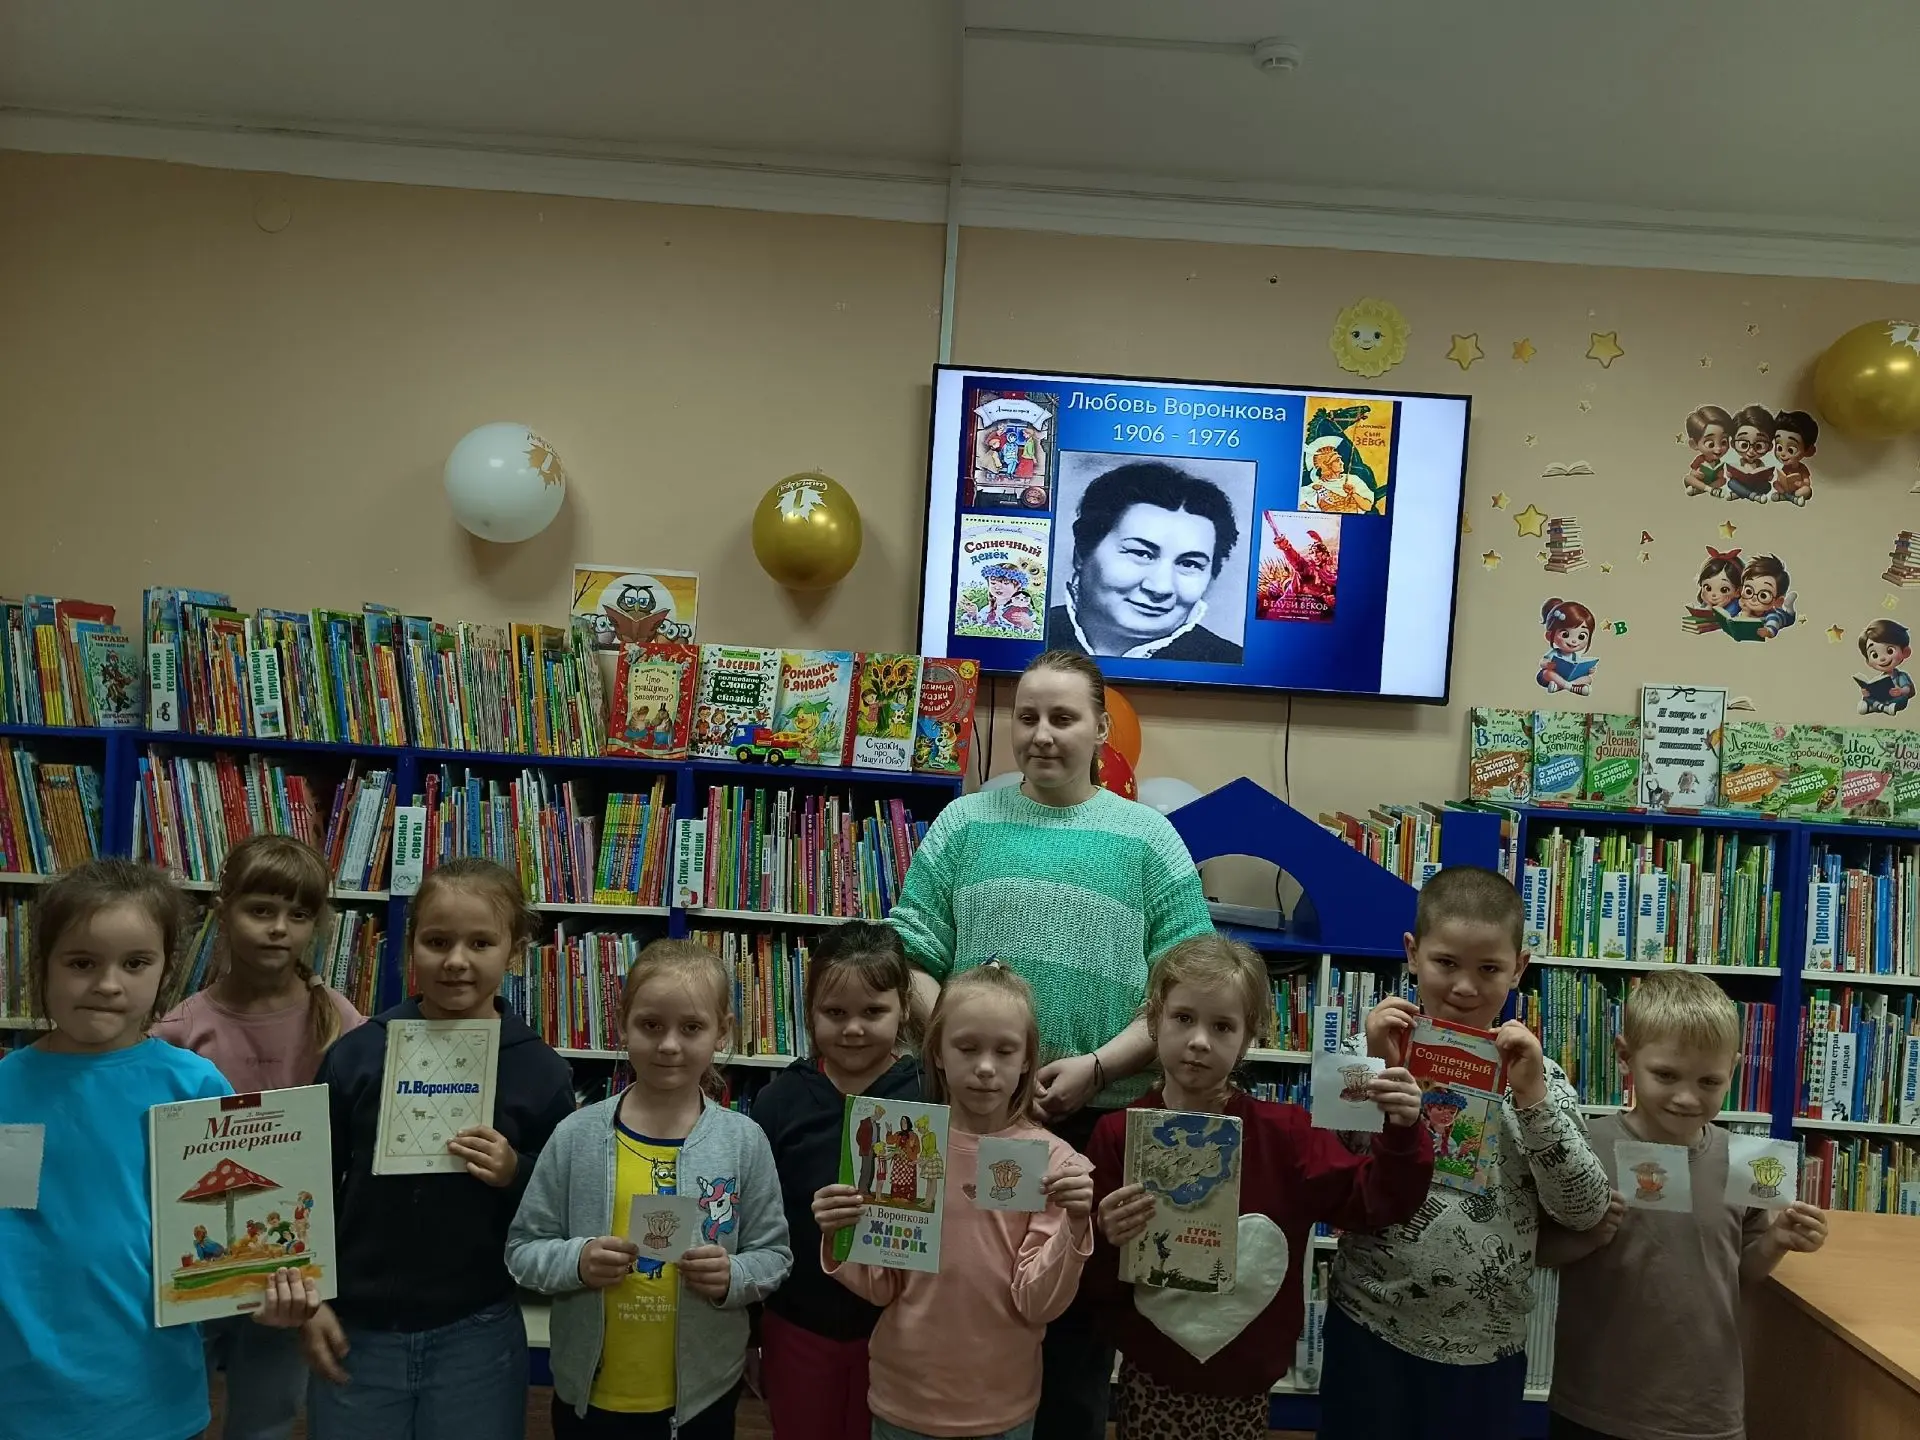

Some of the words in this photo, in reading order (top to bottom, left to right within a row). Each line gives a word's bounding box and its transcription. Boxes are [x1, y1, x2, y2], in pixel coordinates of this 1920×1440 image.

[1067, 391, 1158, 414] Любовь
[1163, 396, 1288, 422] Воронкова
[1113, 423, 1165, 443] 1906
[1187, 428, 1241, 447] 1976
[1355, 437, 1386, 447] ЗЕВСА
[964, 540, 1042, 557] Солнечный
[970, 549, 1009, 565] денёк
[1270, 600, 1298, 609] ГЛУБИ
[1300, 602, 1329, 611] ВЕКОВ
[92, 634, 129, 643] ЧИТАЕМ
[152, 652, 162, 682] мире
[166, 649, 175, 693] техники
[251, 651, 263, 684] живой
[782, 661, 839, 679] РОМАШКИ
[265, 654, 279, 700] природы
[790, 673, 837, 691] ЯНВАРЕ
[254, 686, 265, 705] Мир
[866, 737, 899, 751] Сказки
[1476, 727, 1490, 747] В
[1493, 733, 1528, 748] тайге
[1602, 728, 1638, 747] Лесные
[856, 754, 876, 765] Машу
[885, 755, 905, 767] Ойку
[874, 750, 887, 758] про
[1484, 756, 1516, 771] живой
[1477, 763, 1519, 781] природе
[1540, 767, 1580, 785] природе
[1547, 760, 1577, 775] живой
[1601, 763, 1630, 778] живой
[1594, 769, 1633, 788] природе
[1727, 776, 1774, 795] природе
[1735, 771, 1770, 785] живой
[1790, 773, 1824, 788] живой
[1789, 780, 1828, 797] рироде
[395, 814, 409, 866] Полезные
[411, 822, 423, 859] советы
[681, 820, 691, 857] загадки
[693, 832, 704, 872] потешки
[677, 857, 689, 885] Стихи,
[1536, 868, 1547, 930] природа
[1601, 891, 1614, 919] Мир
[1617, 874, 1628, 936] растений
[1640, 894, 1652, 916] Мир
[1656, 877, 1667, 934] животных
[1812, 885, 1832, 945] Транспорт
[1832, 1033, 1840, 1058] стран
[1908, 1040, 1919, 1067] нашей
[1415, 1047, 1492, 1075] Солнечный
[1430, 1063, 1472, 1080] денёк
[1827, 1060, 1838, 1096] История
[396, 1080, 480, 1097] Л.Воронкова
[1904, 1068, 1917, 1101] История
[203, 1114, 281, 1140] Маша-
[182, 1131, 302, 1160] растеряша
[876, 1208, 930, 1225] Воронкова
[868, 1220, 923, 1239] ЖИВОЙ
[1186, 1226, 1222, 1236] ГУСИ-
[862, 1234, 928, 1254] ФОНАРИК
[1174, 1234, 1221, 1248] ЛЕБЕДИ
